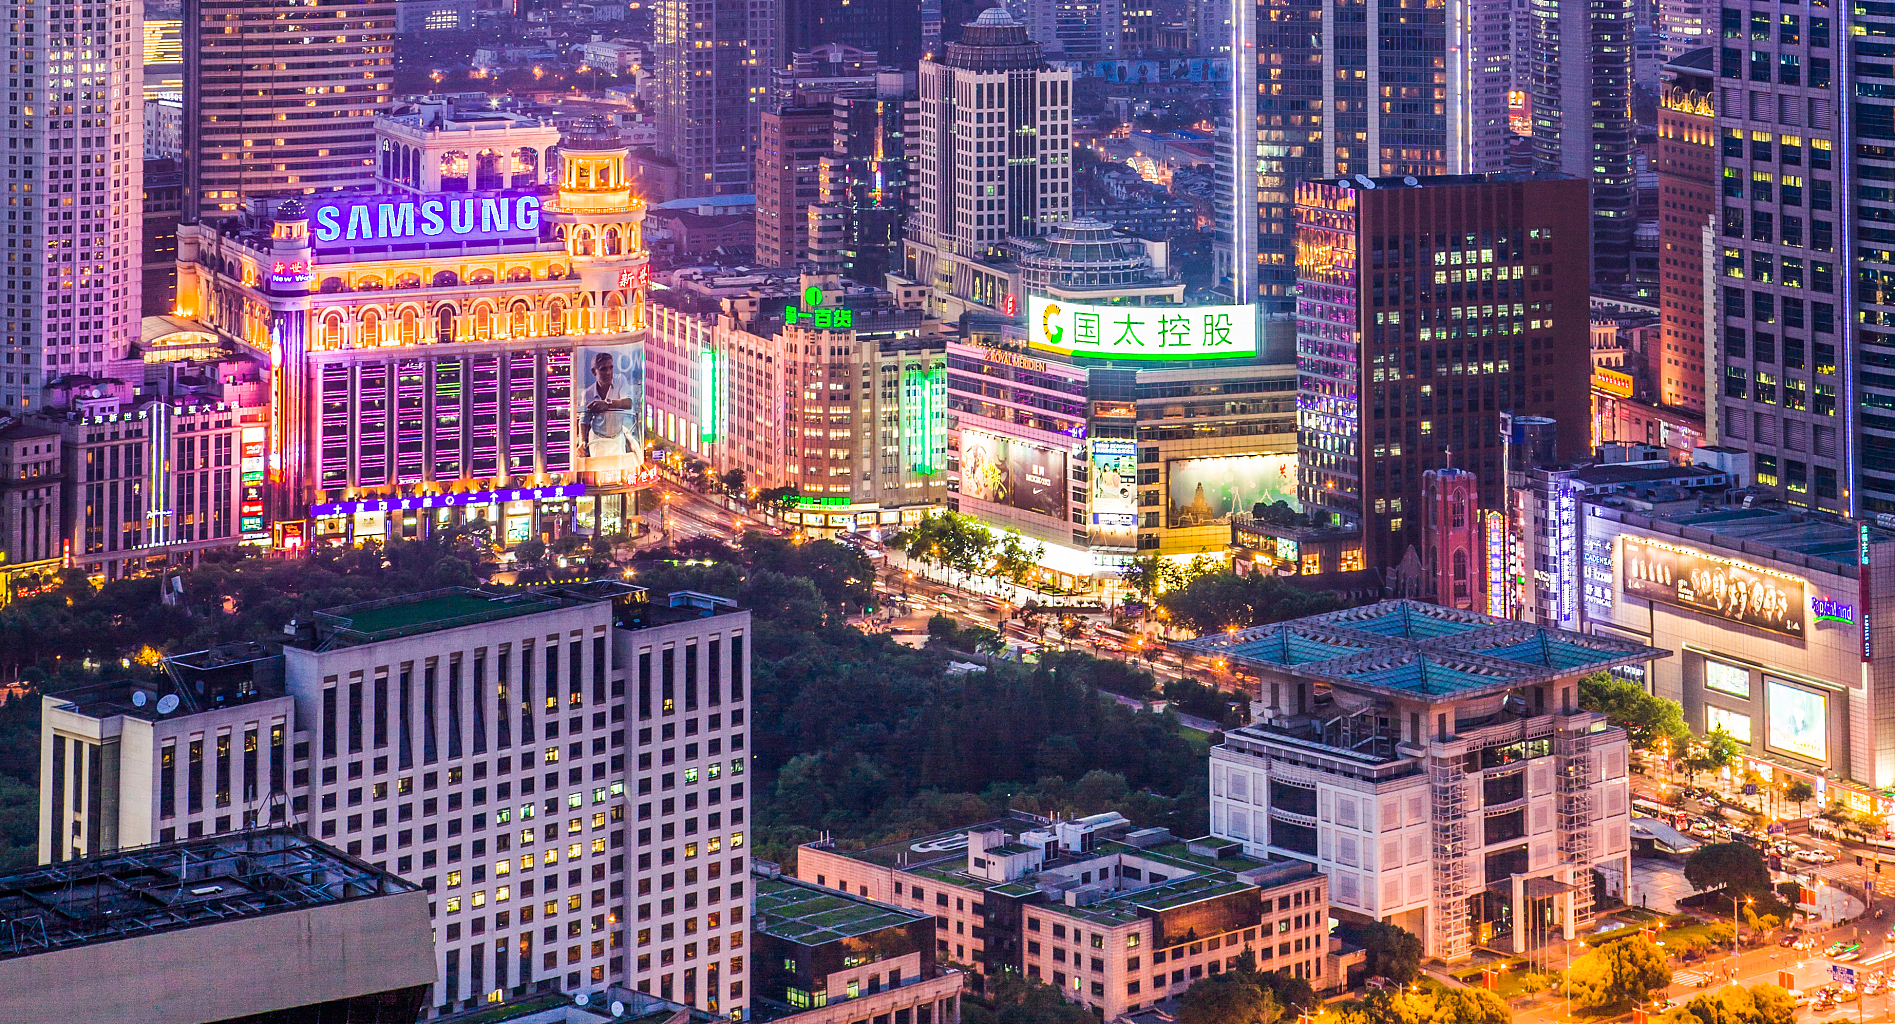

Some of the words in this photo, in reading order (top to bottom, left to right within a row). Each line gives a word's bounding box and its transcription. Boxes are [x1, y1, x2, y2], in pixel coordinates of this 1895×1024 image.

[316, 195, 540, 241] SAMSUNG
[619, 265, 650, 288] 新世
[1074, 312, 1233, 347] 国太控股
[991, 352, 1012, 366] ROYAL
[1013, 356, 1047, 372] MERIDIEN
